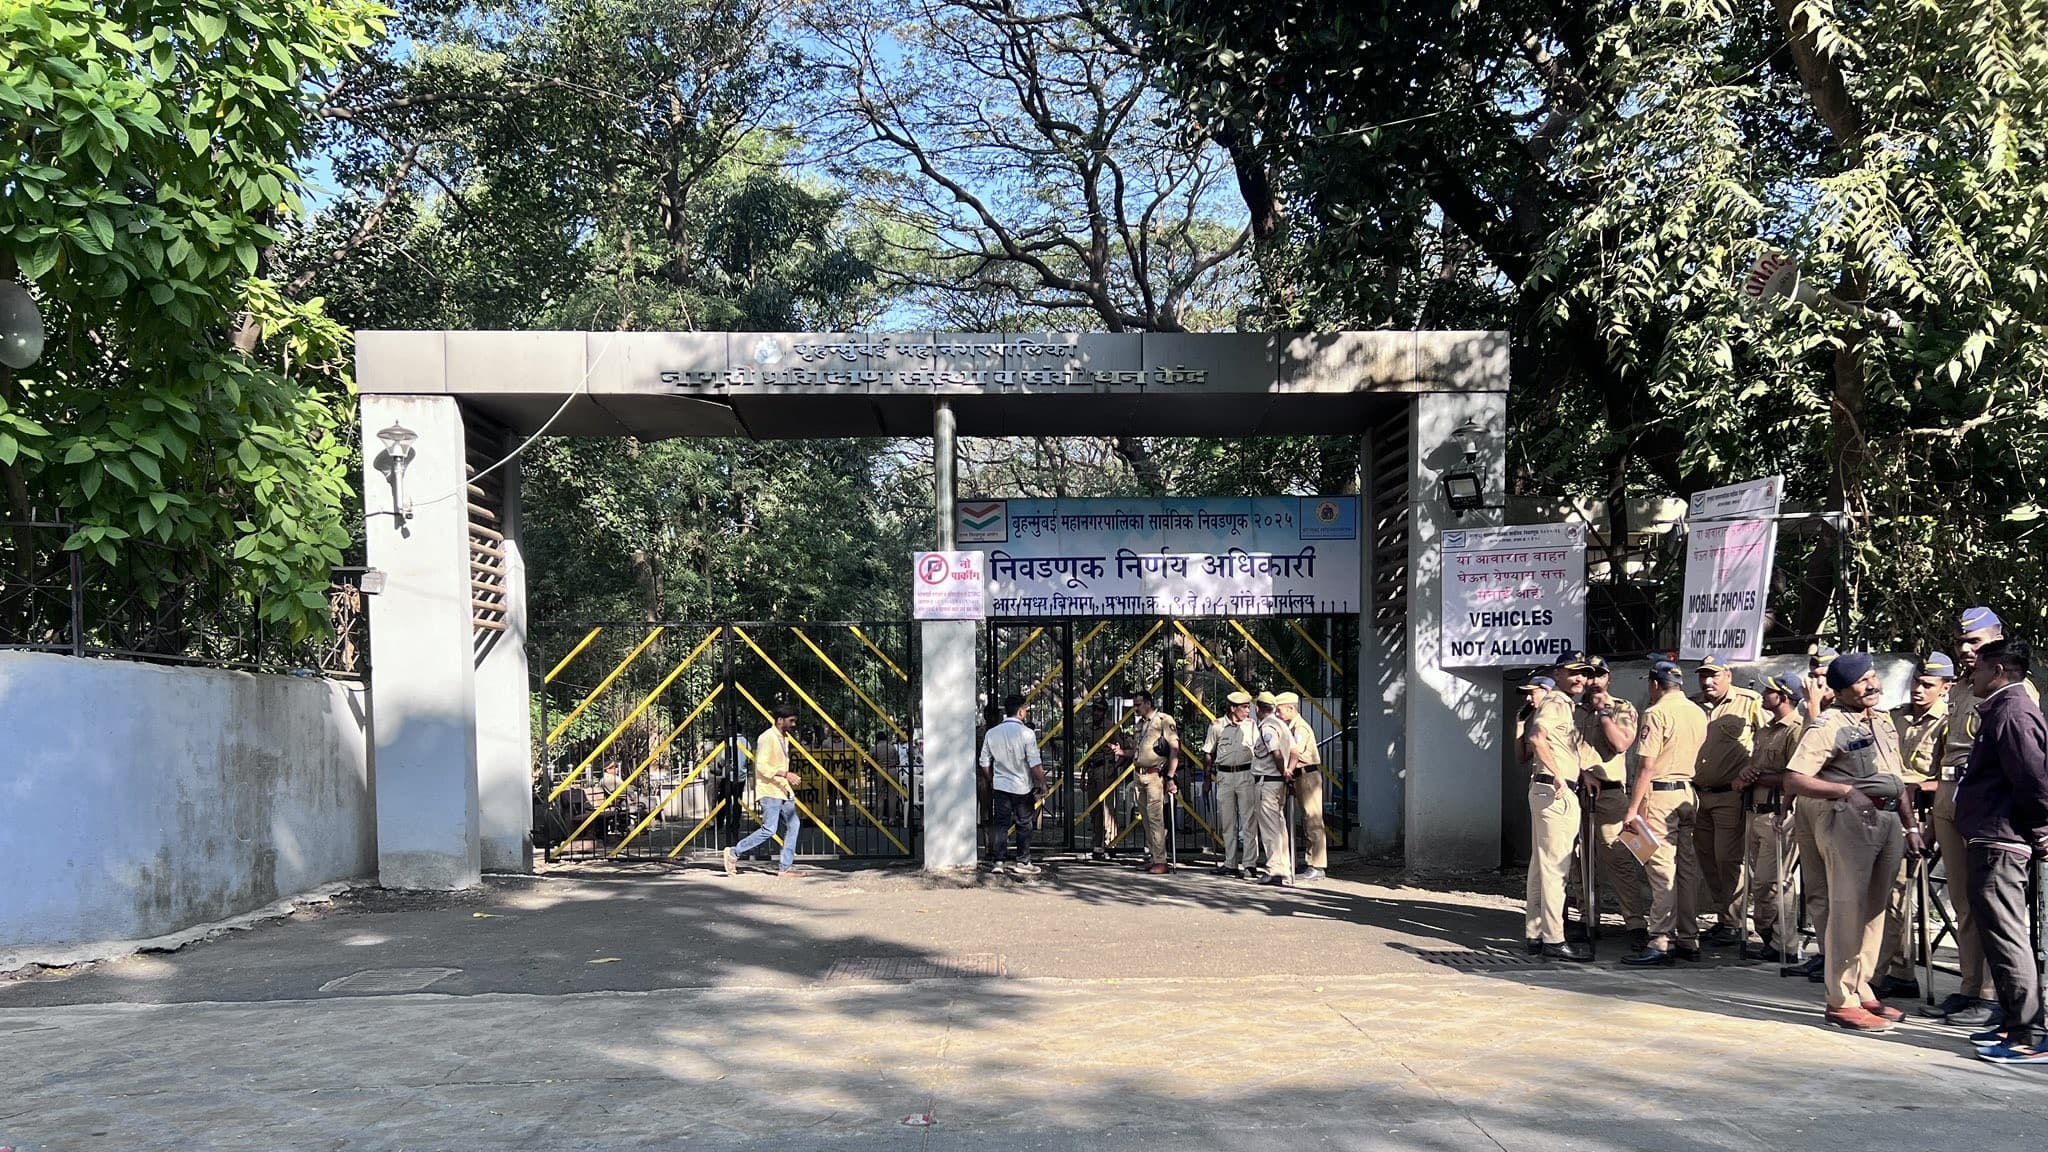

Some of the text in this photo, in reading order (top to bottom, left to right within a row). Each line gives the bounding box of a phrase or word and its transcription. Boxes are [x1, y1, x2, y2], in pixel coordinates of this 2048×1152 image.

[895, 337, 1077, 361] महानगरपालिका
[899, 365, 988, 386] संस्था
[993, 369, 1016, 386] व
[1012, 508, 1058, 538] बृहन्मुंबई
[1061, 510, 1145, 532] महानगरपालिका
[1148, 507, 1194, 531] सार्वत्रिक
[1198, 508, 1249, 536] निवडणूक
[1254, 512, 1294, 529] २०२५
[989, 545, 1317, 588] निवडणूक निर्णय अधिकारी
[1456, 550, 1569, 566] या आवारात वाहन
[1456, 570, 1489, 583] घेऊन
[1688, 590, 1757, 614] MOBILE PHONES
[1469, 609, 1553, 628] VEHICLES
[1451, 638, 1572, 656] NOT ALLOWED
[1690, 628, 1747, 649] NOT ALLOWED
